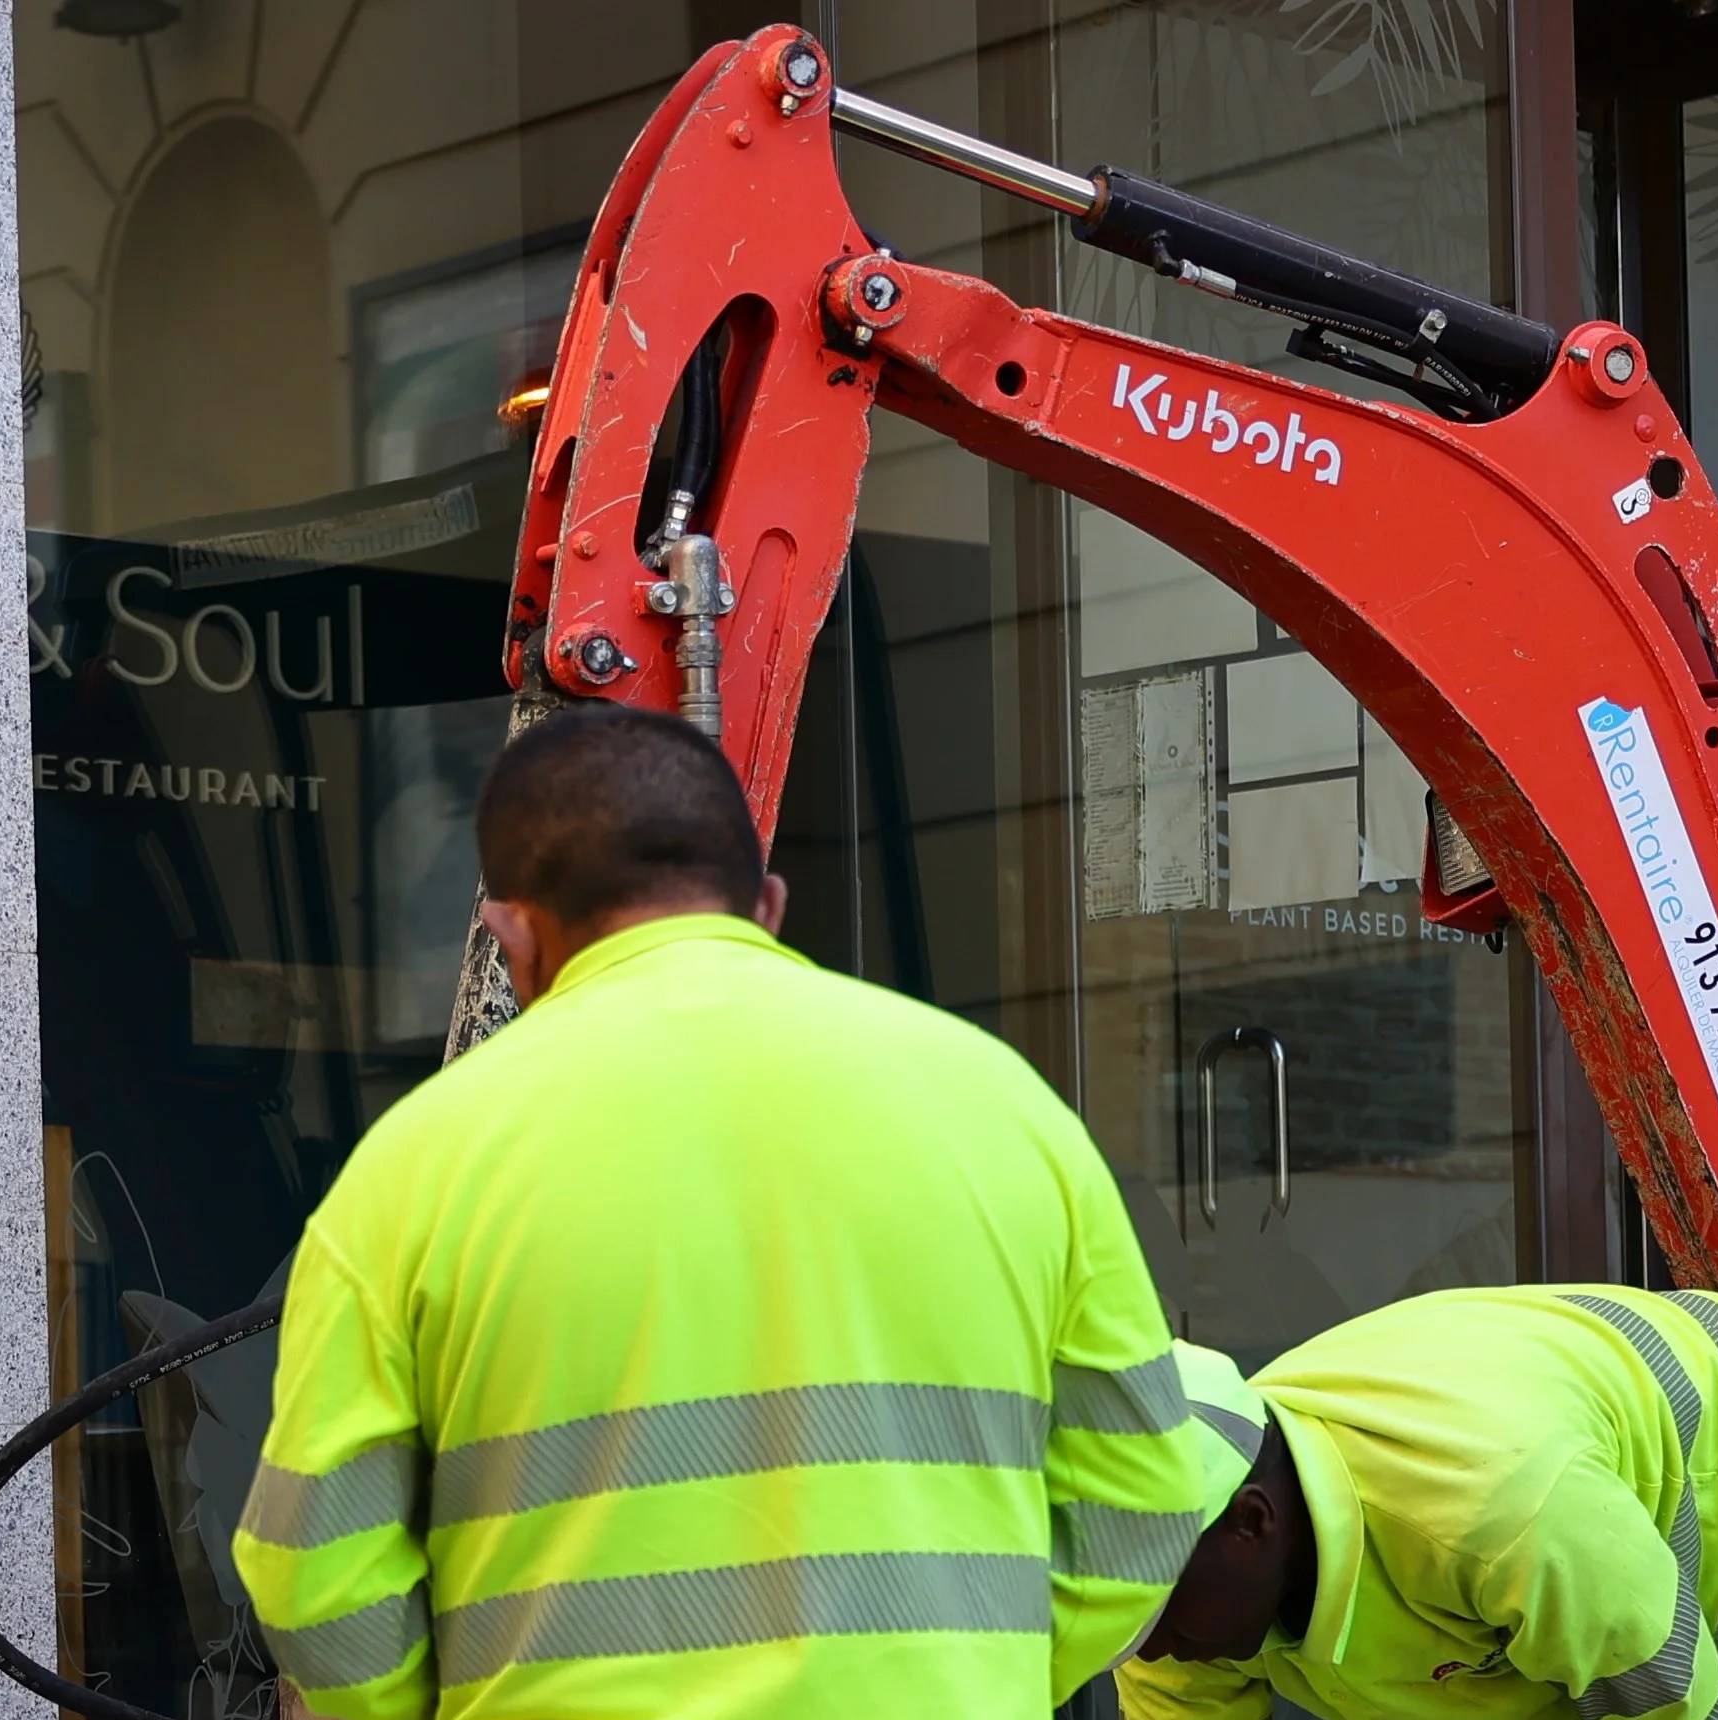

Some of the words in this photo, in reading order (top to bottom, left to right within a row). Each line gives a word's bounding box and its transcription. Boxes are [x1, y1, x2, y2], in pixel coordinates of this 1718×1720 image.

[1111, 363, 1343, 486] Kubota
[106, 563, 365, 707] Soul
[29, 754, 327, 812] ESTAURANT
[1598, 726, 1683, 924] Rentaire
[1230, 905, 1312, 930] PLANT
[1325, 908, 1406, 938] BASED
[1669, 939, 1705, 1014] ALQUILER
[1697, 1013, 1715, 1036] DE
